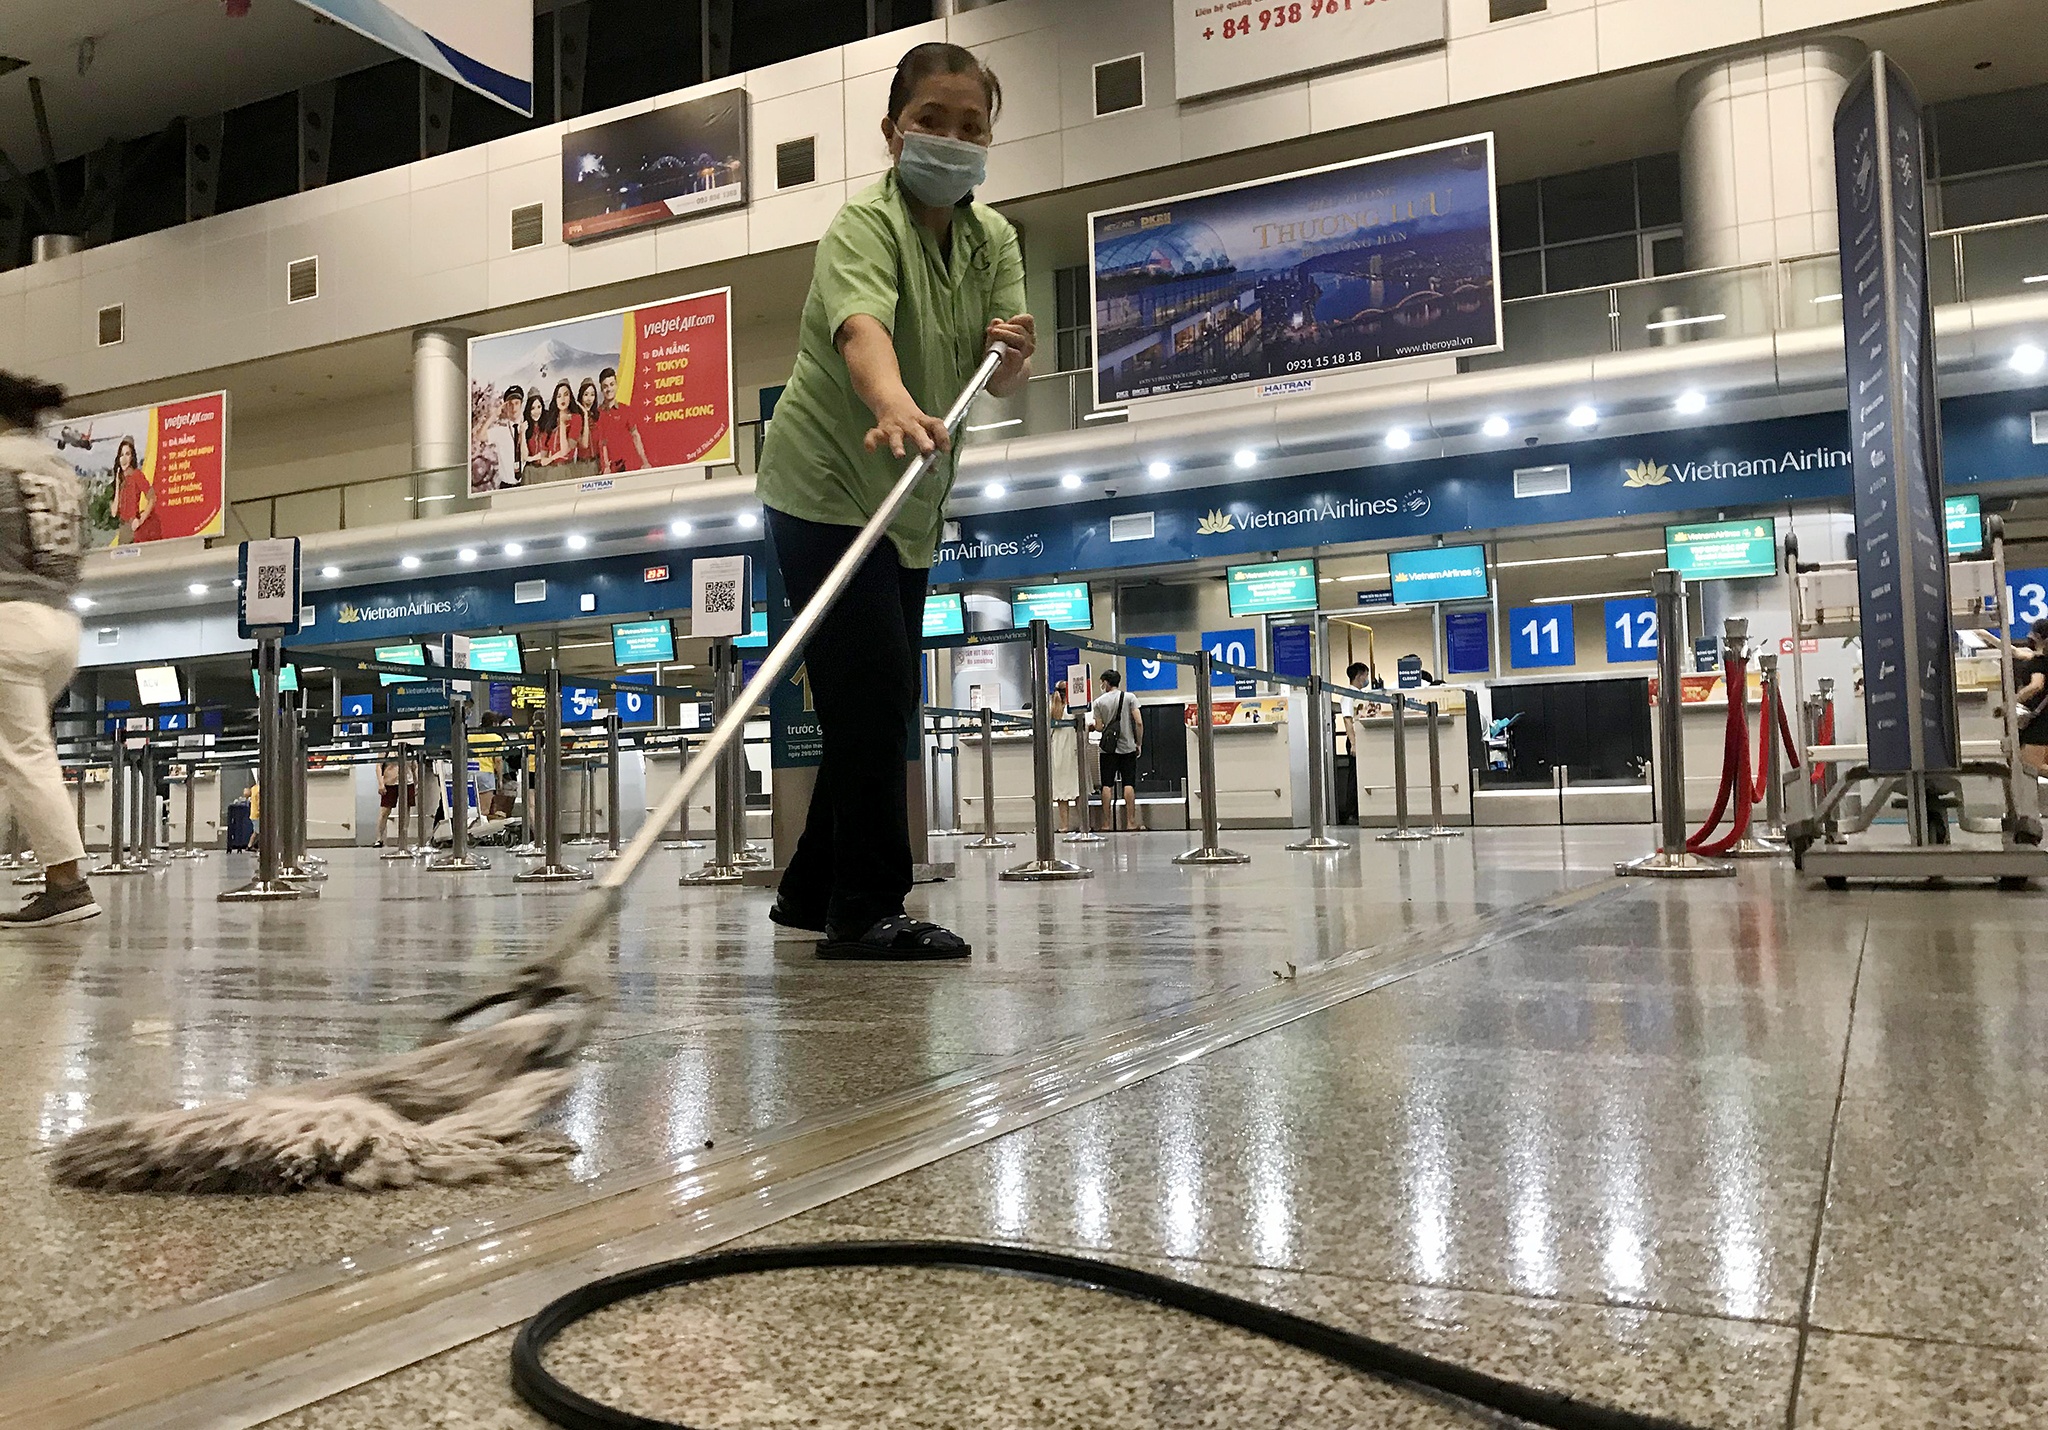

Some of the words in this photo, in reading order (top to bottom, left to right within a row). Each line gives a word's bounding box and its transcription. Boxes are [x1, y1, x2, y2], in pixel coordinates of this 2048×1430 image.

[1222, 14, 1251, 40] 84
[1258, 2, 1302, 31] 938
[655, 357, 689, 372] TOKYO
[1286, 358, 1312, 372] 0931
[1316, 356, 1329, 368] 15
[1332, 353, 1345, 365] 18
[1348, 350, 1362, 363] 18
[1395, 336, 1473, 356] www.theroyal.vn
[654, 375, 684, 389] TAIPEI
[654, 392, 685, 406] SEOUL
[655, 408, 684, 422] HONG
[685, 403, 714, 418] KONG
[1672, 457, 1777, 483] Vietnam
[1235, 507, 1318, 531] Vietnam
[1319, 498, 1398, 521] Airlines
[956, 541, 1019, 560] Airlines
[360, 605, 407, 621] Vietnam
[407, 600, 451, 616] Airlines
[2006, 583, 2048, 624] 13
[1521, 618, 1559, 655] 11
[1615, 610, 1658, 649] 12
[1141, 658, 1161, 680] 9
[1210, 641, 1246, 675] 10
[573, 688, 586, 715] 5
[627, 692, 642, 712] 6
[786, 723, 815, 735] trước
